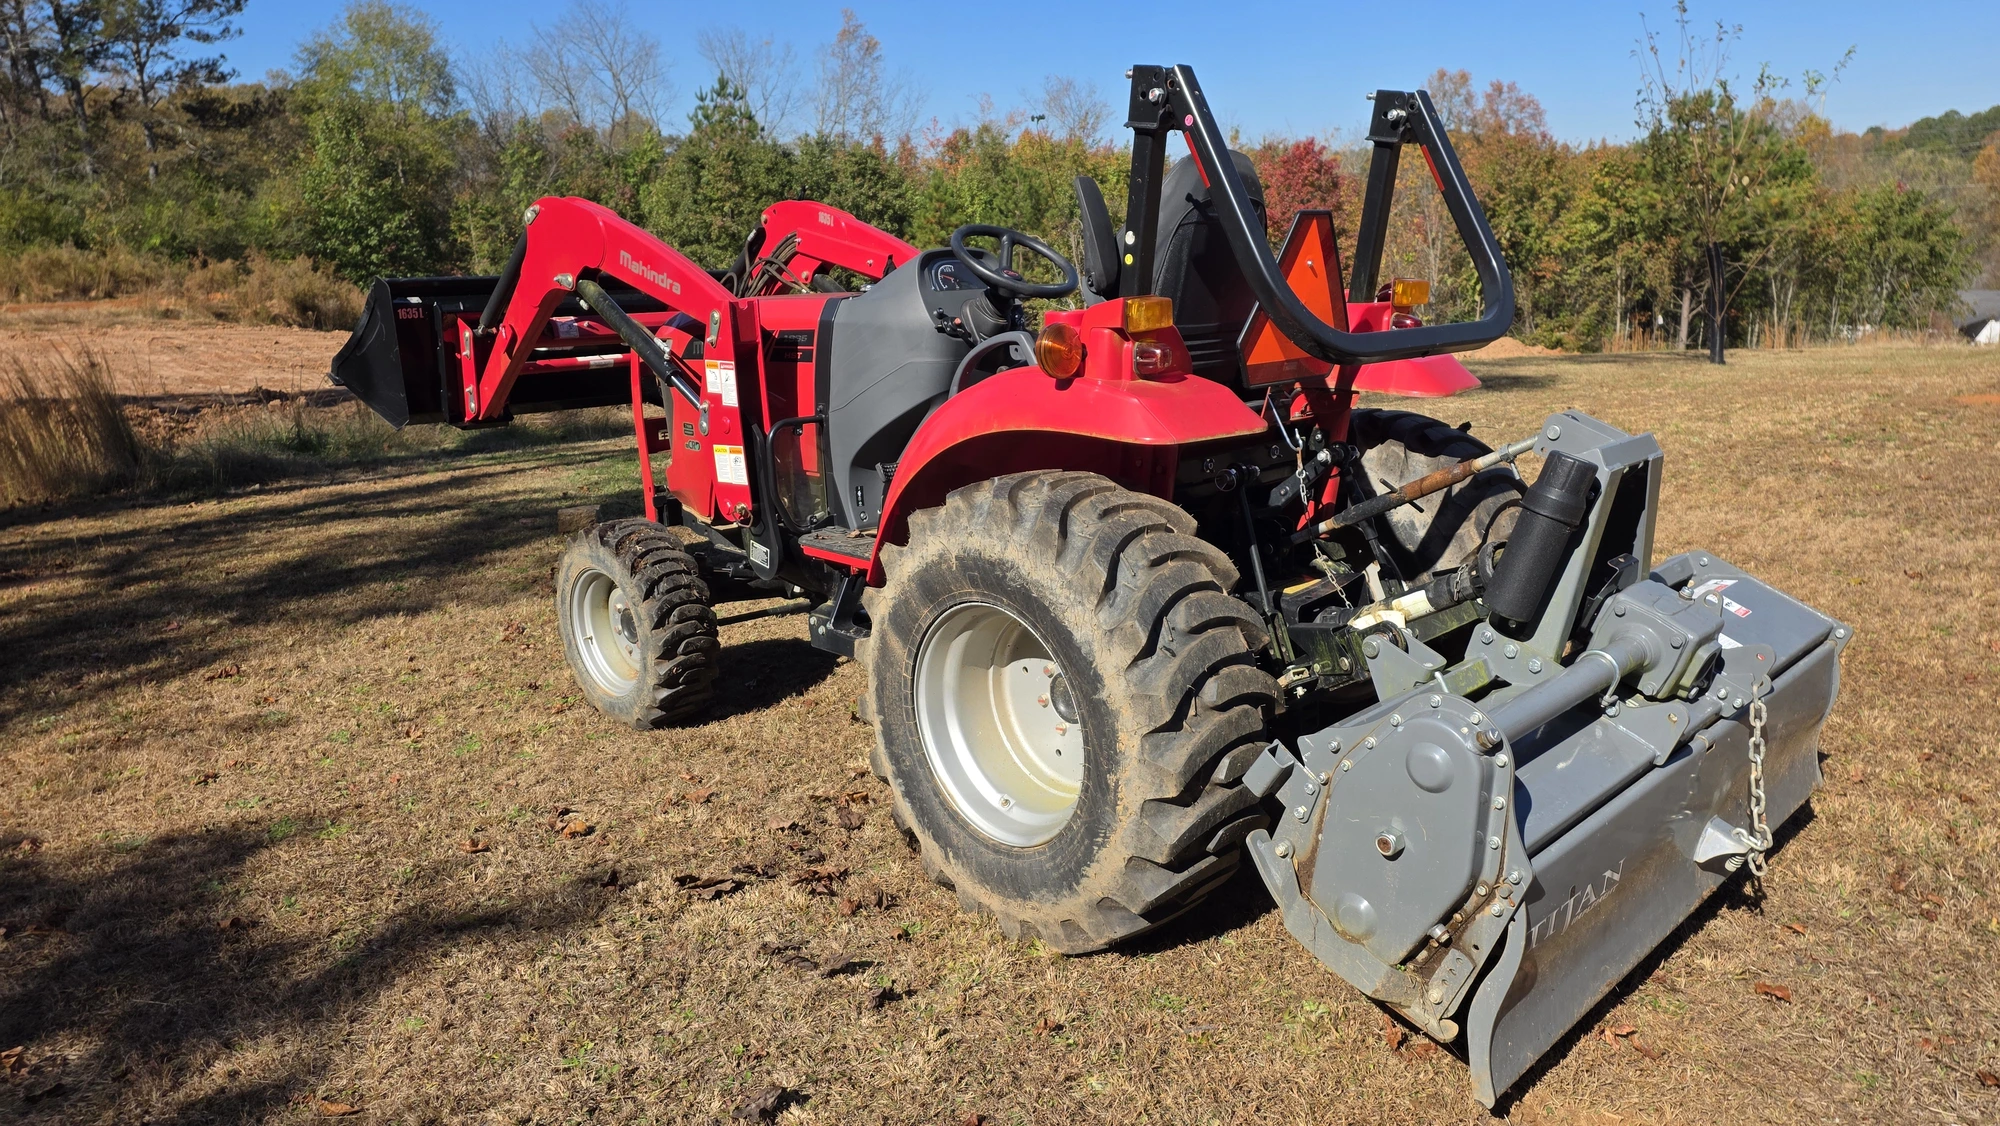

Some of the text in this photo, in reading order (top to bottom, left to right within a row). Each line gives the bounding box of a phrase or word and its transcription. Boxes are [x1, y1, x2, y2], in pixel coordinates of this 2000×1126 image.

[620, 250, 681, 295] Mahindra
[398, 308, 418, 319] 1635
[1527, 857, 1626, 953] TITAN
